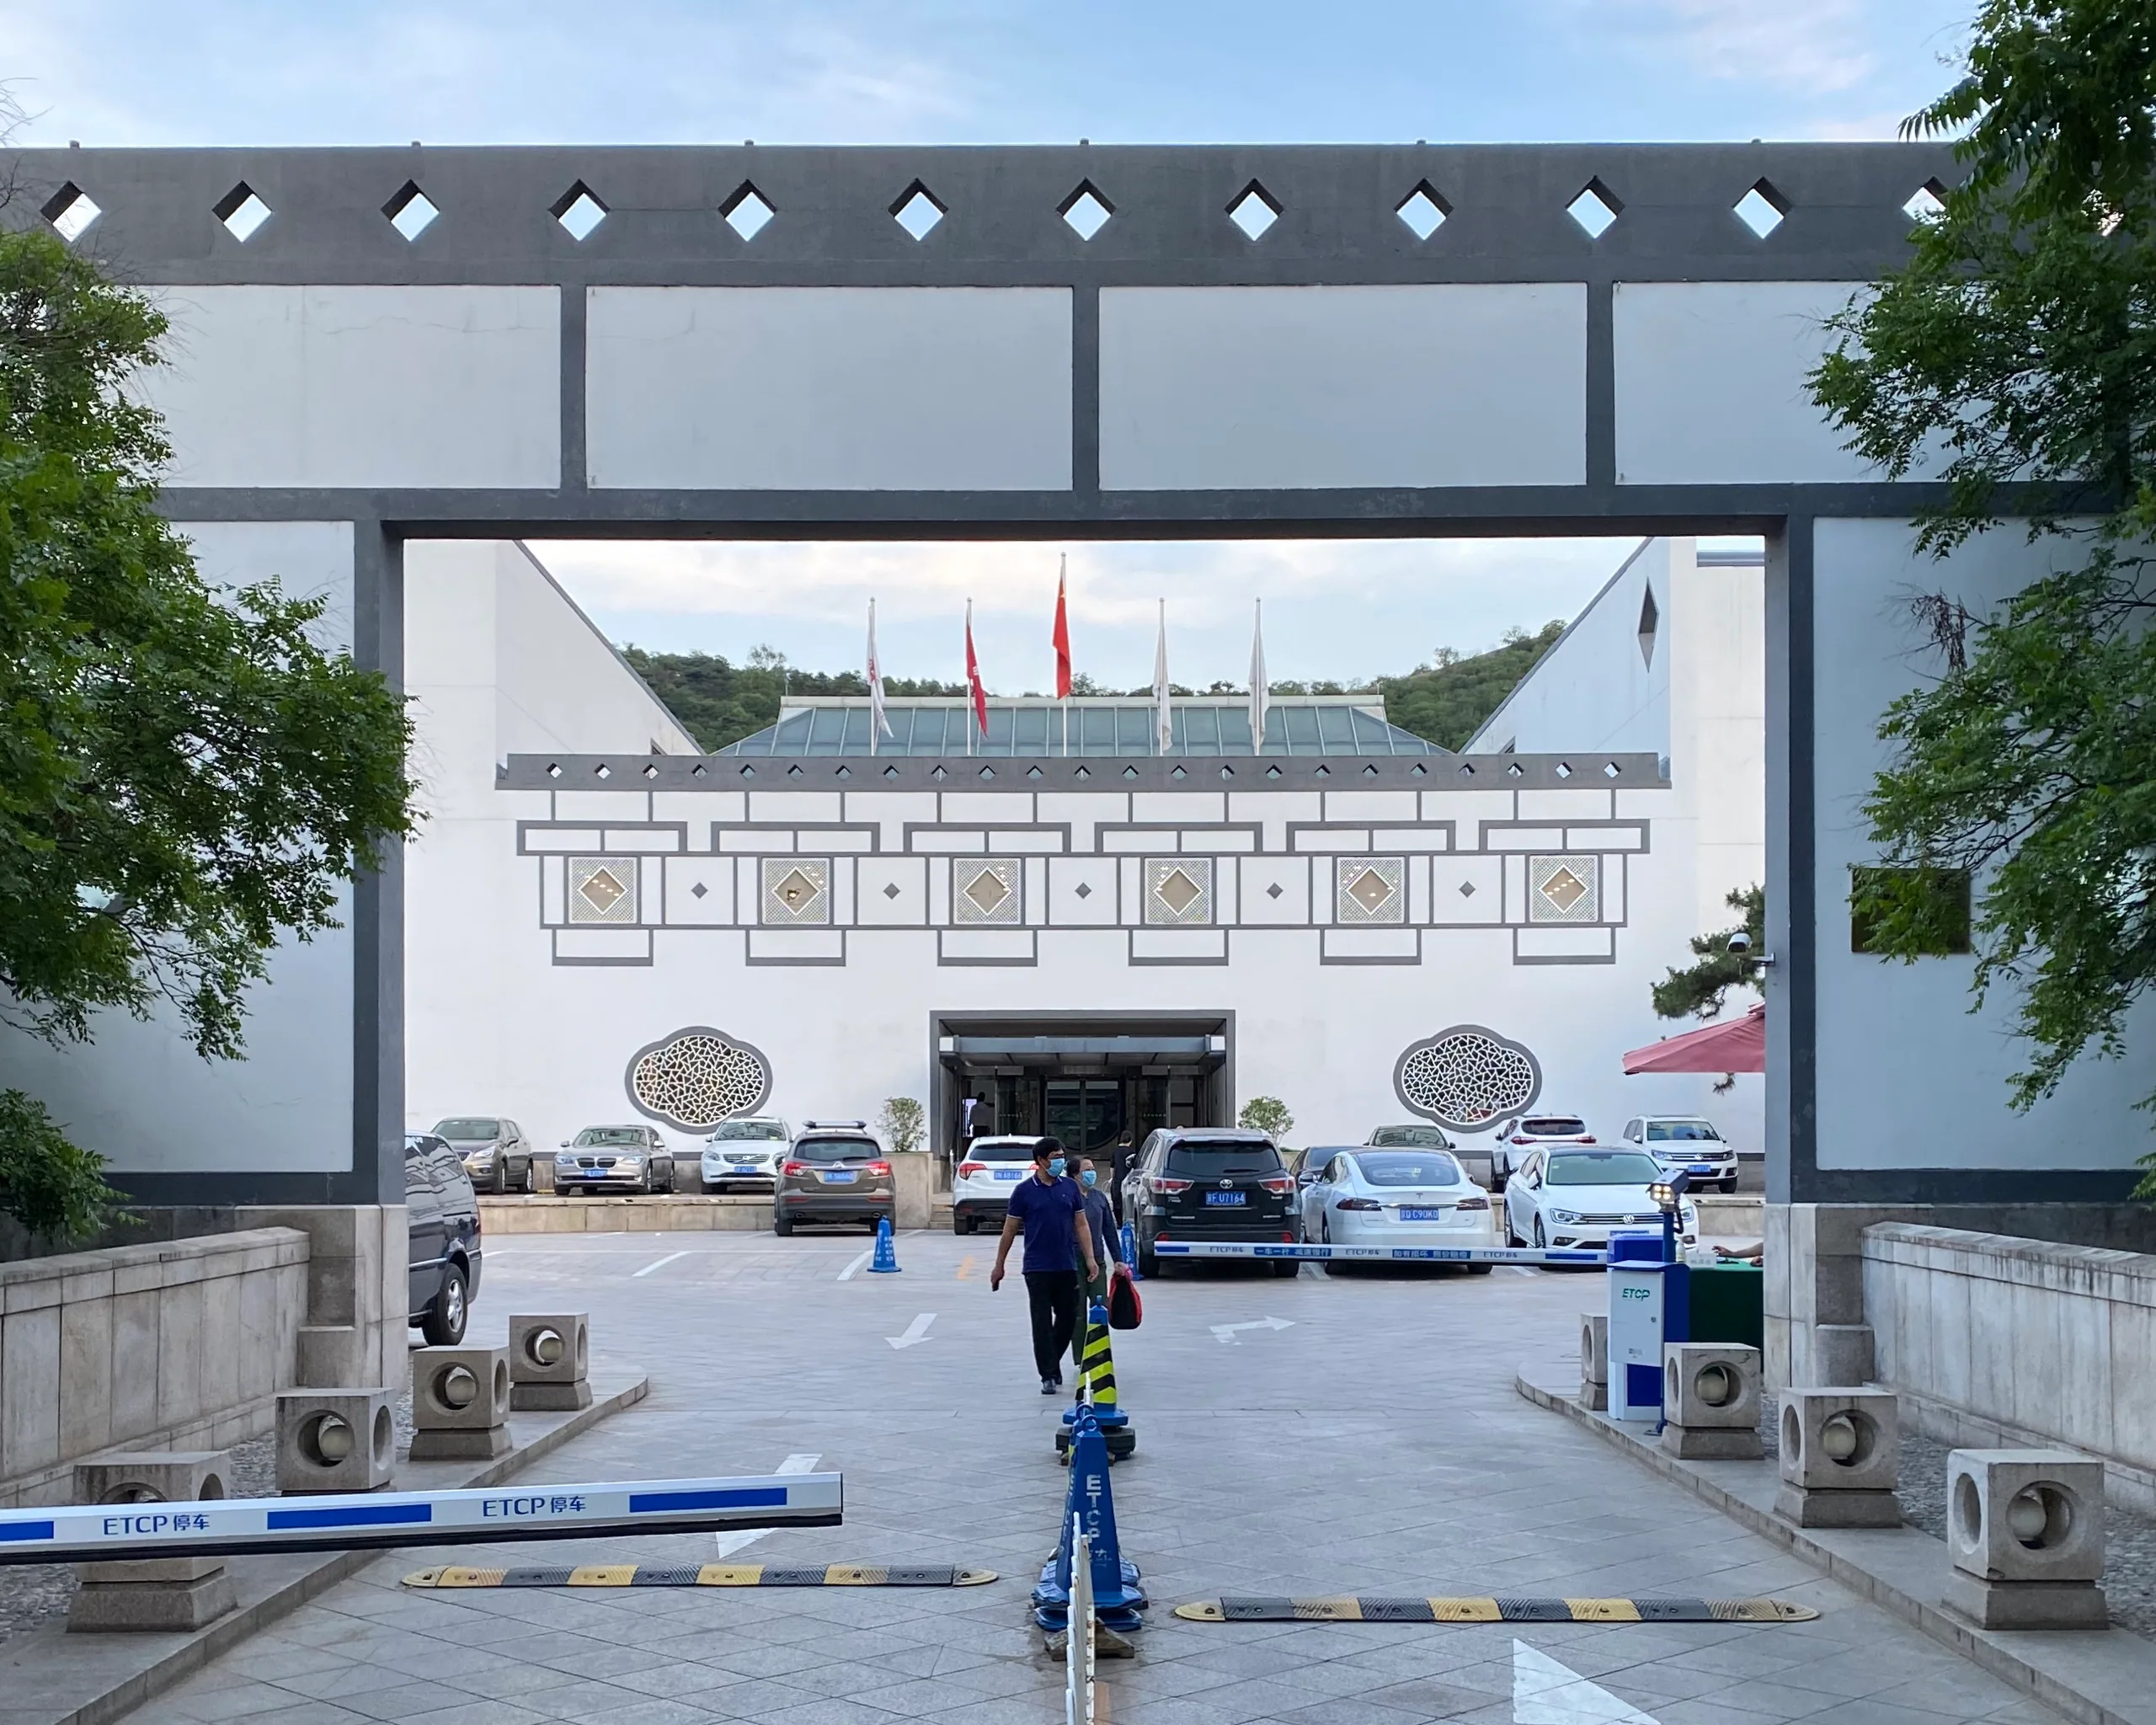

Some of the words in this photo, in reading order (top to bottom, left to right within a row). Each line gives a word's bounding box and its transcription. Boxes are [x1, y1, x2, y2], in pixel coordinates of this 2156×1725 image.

[1622, 1288, 1651, 1301] ETCP
[483, 1498, 545, 1517] ETCP
[551, 1496, 586, 1514] 停车
[1086, 1474, 1102, 1544] ETCP
[104, 1515, 168, 1535] ETCP
[173, 1514, 211, 1531] 停车
